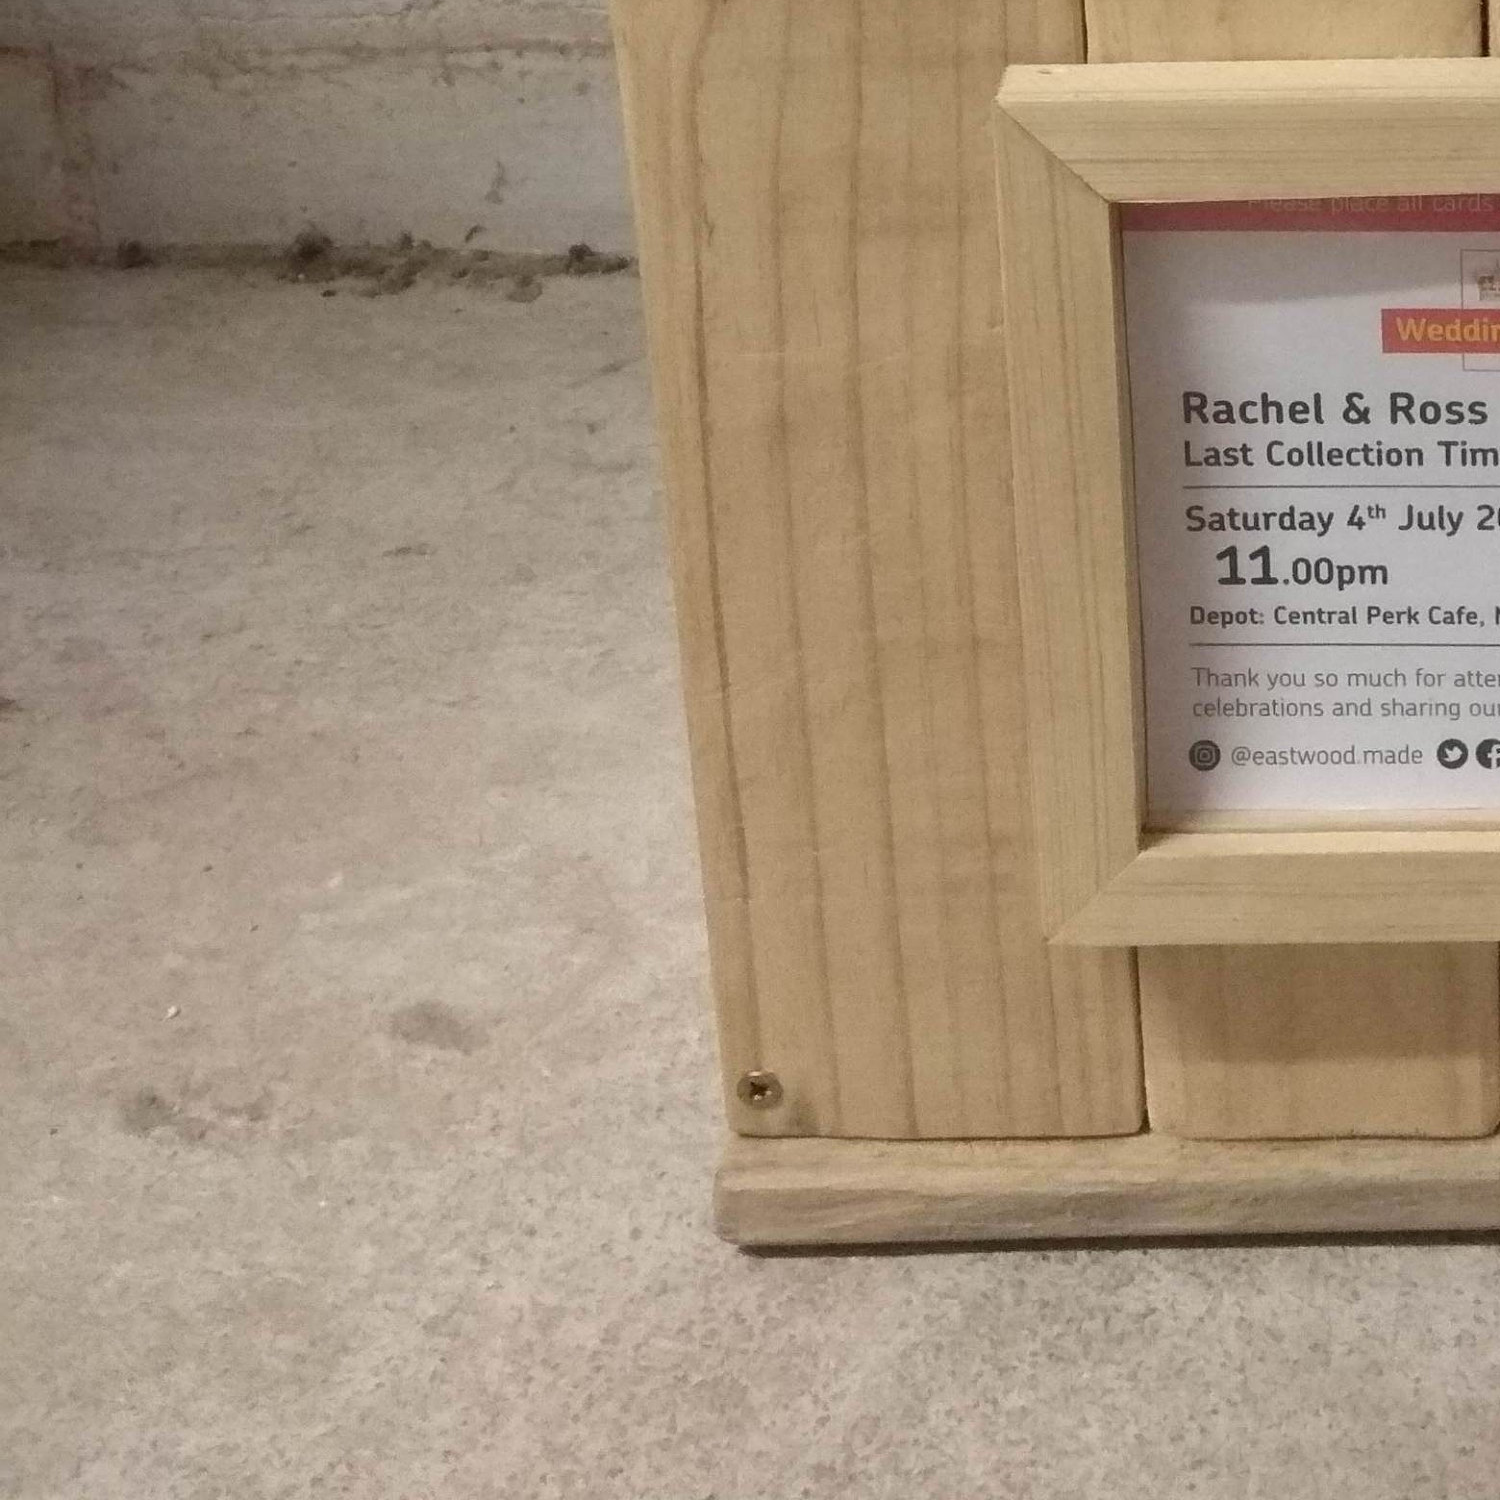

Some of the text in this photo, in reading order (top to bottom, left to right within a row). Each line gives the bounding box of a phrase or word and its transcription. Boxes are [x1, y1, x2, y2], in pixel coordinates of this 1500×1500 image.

[1432, 193, 1495, 213] cards
[1183, 390, 1489, 425] Rachel & Ross
[1184, 440, 1254, 467] Last
[1266, 440, 1424, 467] Collection
[1185, 504, 1335, 537] Saturday
[1346, 503, 1387, 531] 4th
[1398, 504, 1465, 537] July
[1215, 544, 1389, 591] 11.00pm
[1189, 605, 1265, 628] Depot:
[1273, 605, 1358, 626] Central
[1366, 605, 1420, 626] Perk
[1428, 606, 1485, 629] Cafe,
[1191, 667, 1261, 688] Thank
[1266, 671, 1306, 691] you
[1314, 671, 1339, 688] so
[1347, 668, 1406, 688] much
[1415, 668, 1446, 688] for
[1192, 698, 1324, 717] celebrations
[1331, 698, 1373, 717] and
[1380, 698, 1462, 721] sharing
[1231, 744, 1424, 766] @eastwood.made
